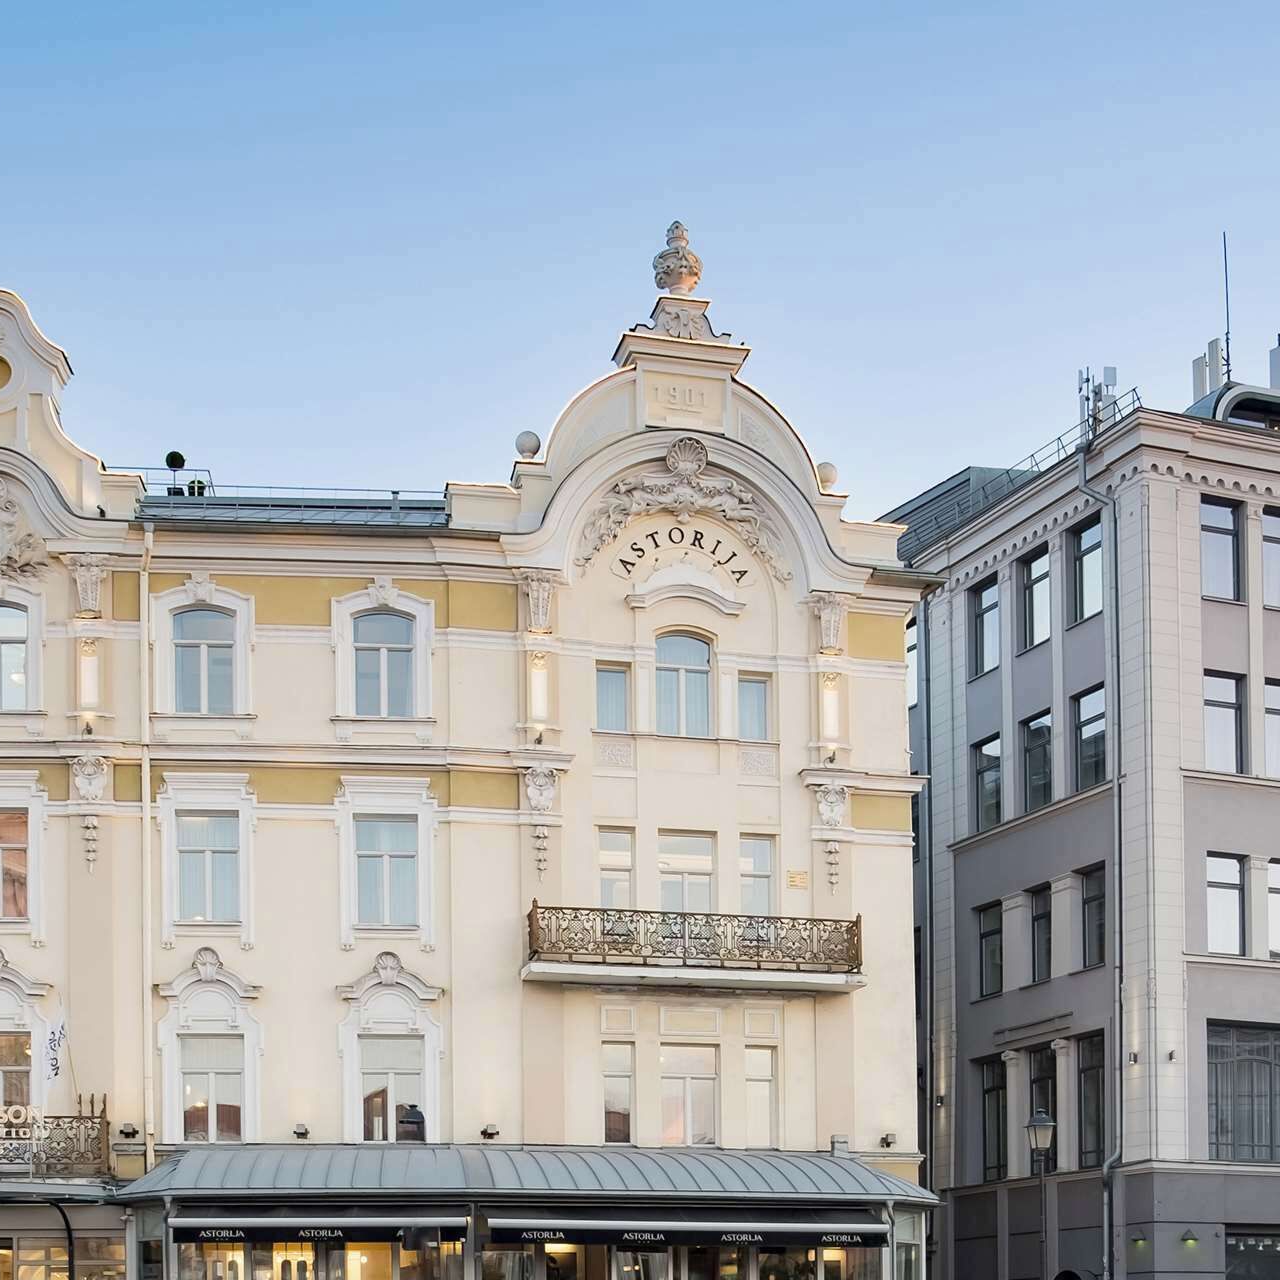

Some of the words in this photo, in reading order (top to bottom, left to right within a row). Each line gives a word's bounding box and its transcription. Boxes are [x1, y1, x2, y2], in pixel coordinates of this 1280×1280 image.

[618, 526, 749, 584] ASTORIJA
[199, 1229, 245, 1238] ASTORIJA
[298, 1229, 343, 1238] ASTORIJA
[521, 1231, 565, 1240] ASTORIJA
[622, 1232, 665, 1241] ASTORIJA
[720, 1233, 763, 1242] ASTORIJA
[821, 1235, 862, 1243] ASTORIJA
